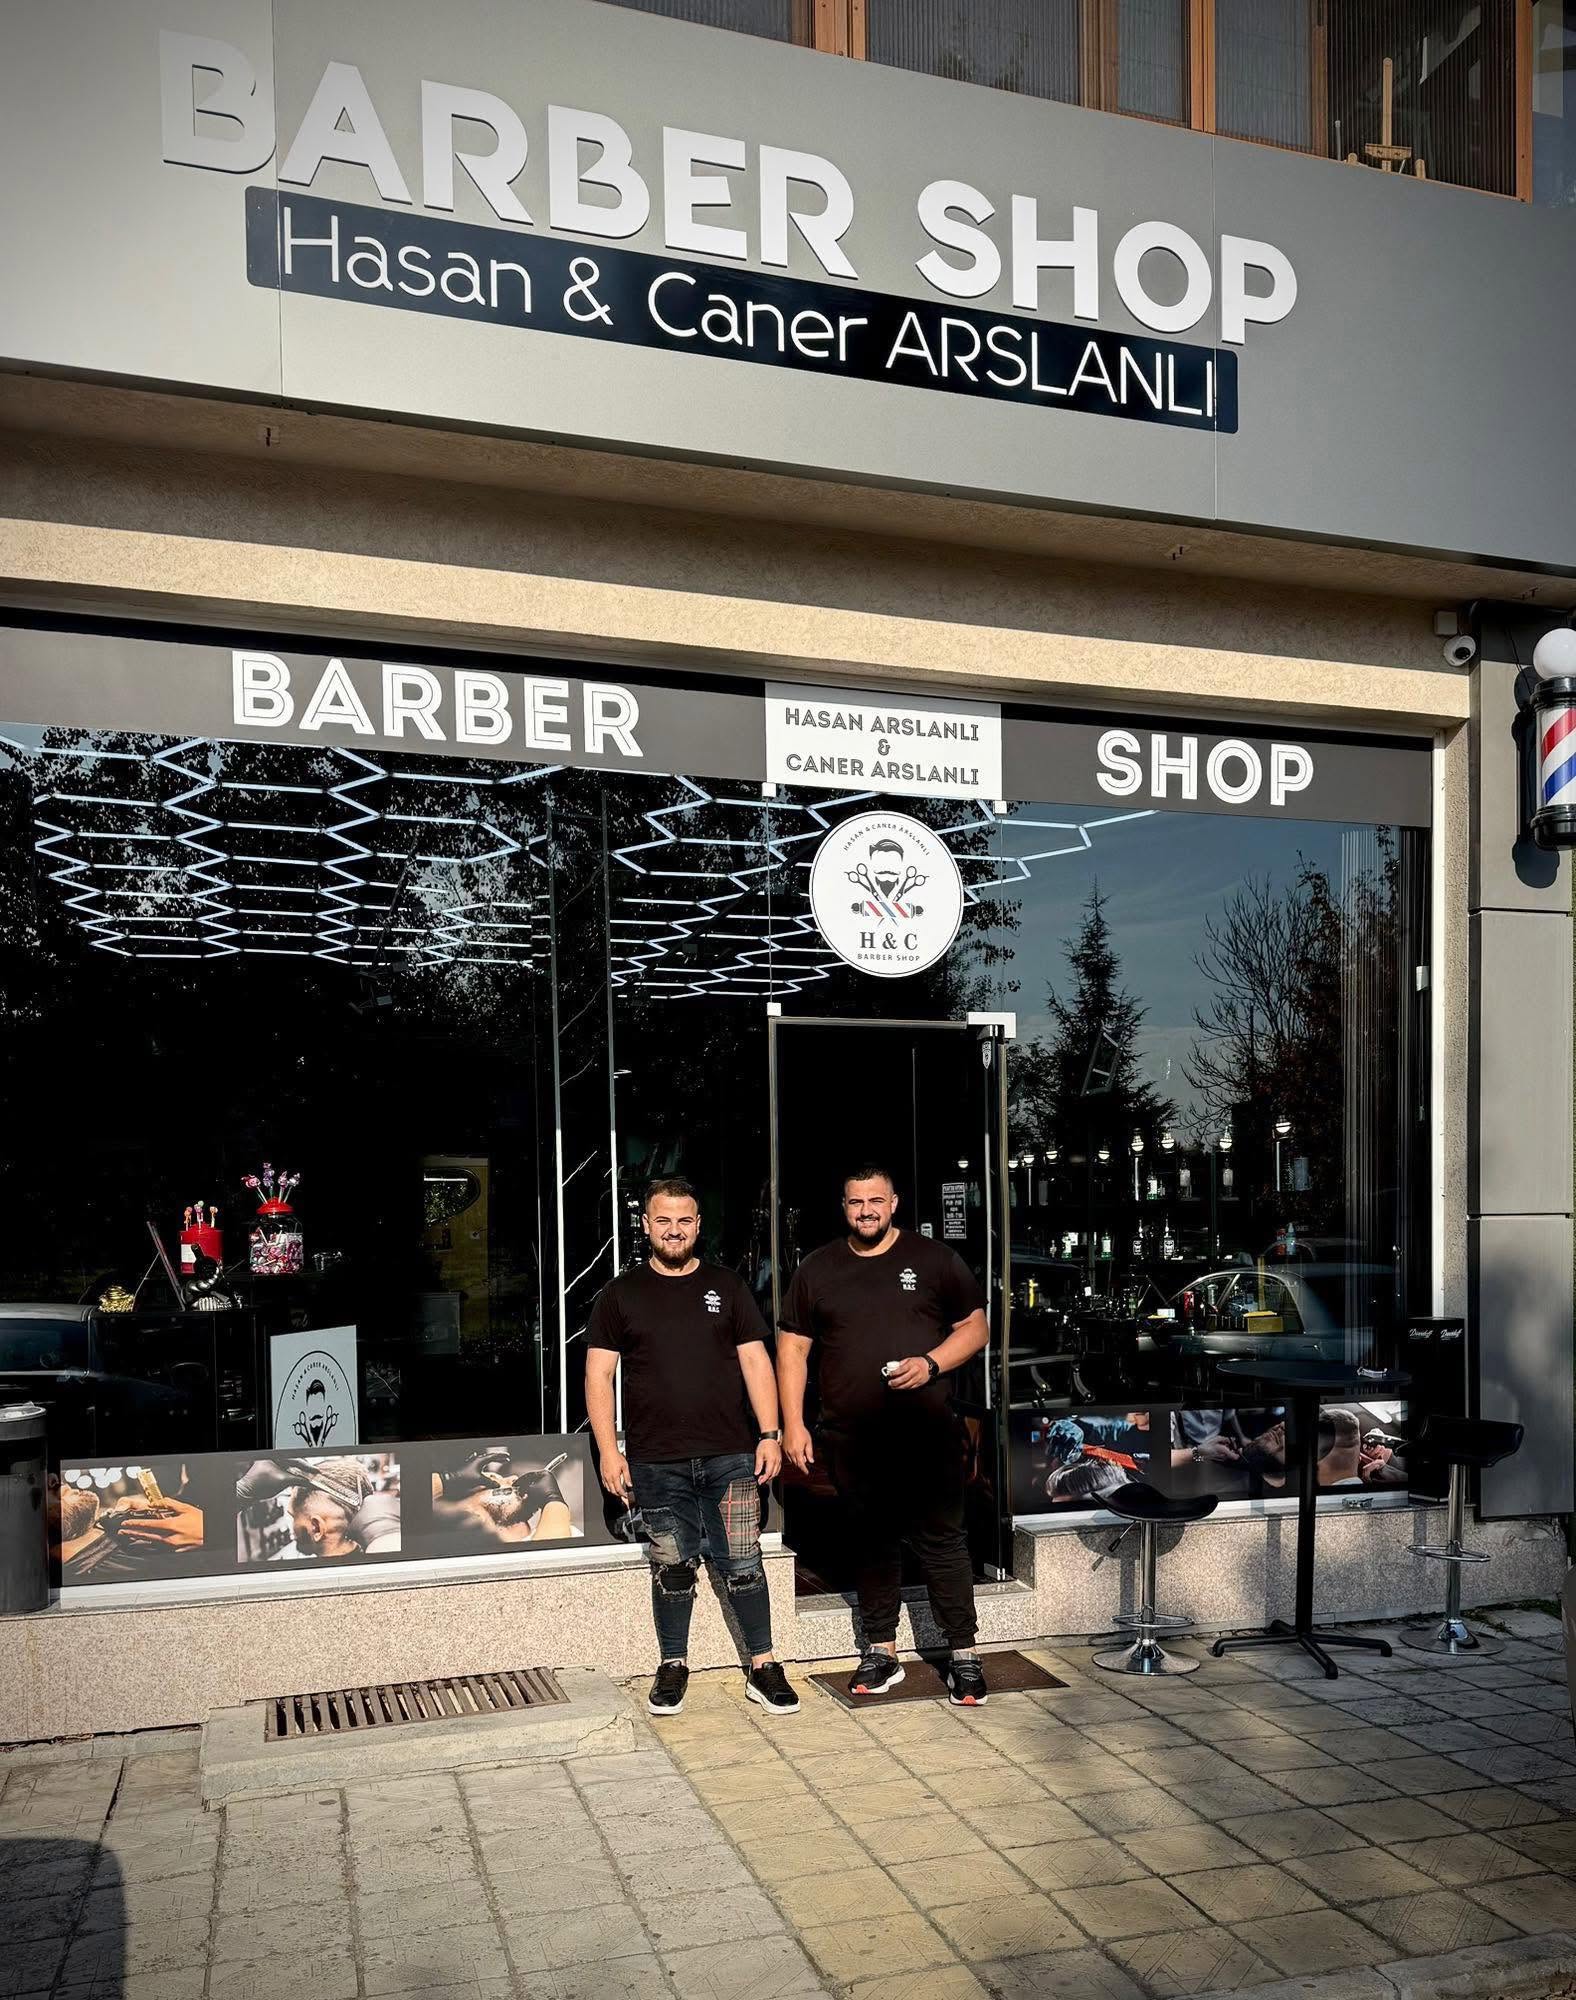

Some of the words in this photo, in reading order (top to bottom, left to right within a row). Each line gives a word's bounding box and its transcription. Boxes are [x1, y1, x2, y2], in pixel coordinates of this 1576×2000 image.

[159, 29, 858, 279] BARBER
[914, 179, 1298, 345] SHOP
[282, 206, 532, 314] Hasan
[563, 256, 613, 326] &
[648, 272, 868, 363] Caner
[885, 311, 1214, 418] ARSLANLI
[231, 650, 644, 758] BARBER
[1096, 729, 1314, 806] SHOP
[785, 707, 863, 731] HASAN
[870, 716, 979, 741] ARSLANLI
[877, 738, 890, 756] &
[786, 753, 864, 777] CANER
[870, 761, 979, 785] ARSLANLI
[843, 831, 864, 851] HASAN
[859, 931, 876, 949] H
[882, 932, 898, 950] &
[904, 933, 918, 951] C
[857, 953, 893, 961] BARBER
[896, 954, 920, 962] SHOP
